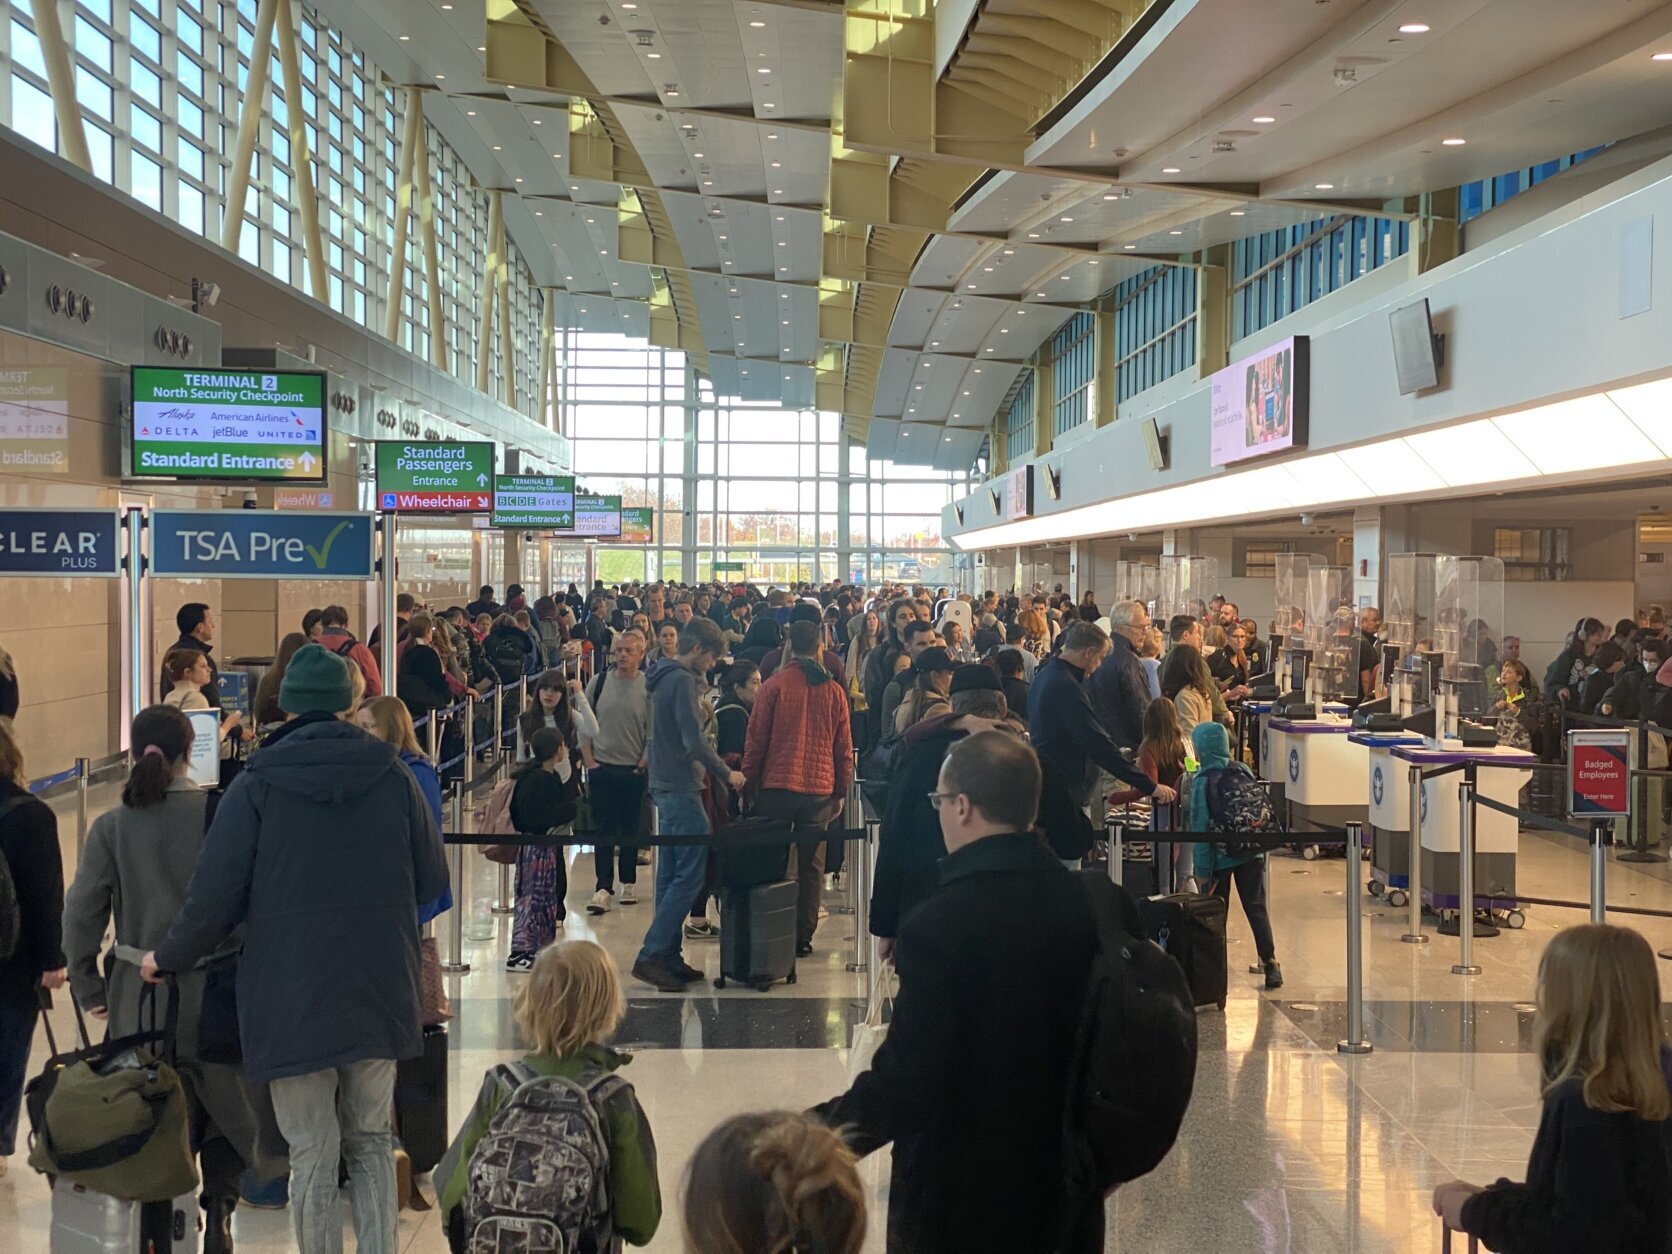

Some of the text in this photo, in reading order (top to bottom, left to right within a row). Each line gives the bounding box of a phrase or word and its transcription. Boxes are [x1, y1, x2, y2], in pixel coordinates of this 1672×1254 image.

[184, 374, 258, 389] TERMINAL
[153, 386, 304, 403] North Security Checkpoint
[158, 408, 289, 423] Alaska American Airlines
[155, 427, 303, 439] DELTA jetBlue UNITED
[403, 446, 465, 459] Standard
[141, 451, 295, 470] Standard Entrance
[397, 458, 473, 473] Passengers
[412, 475, 458, 486] Entrance
[400, 494, 472, 507] Wheelchair
[539, 498, 567, 506] Gates
[495, 514, 561, 523] Standard Entrance
[576, 514, 607, 523] andard
[0, 531, 96, 554] LEAR
[176, 530, 305, 562] TSA Pre
[61, 557, 97, 568] PLUS
[1584, 760, 1613, 770] Badged
[1579, 771, 1618, 780] Employees
